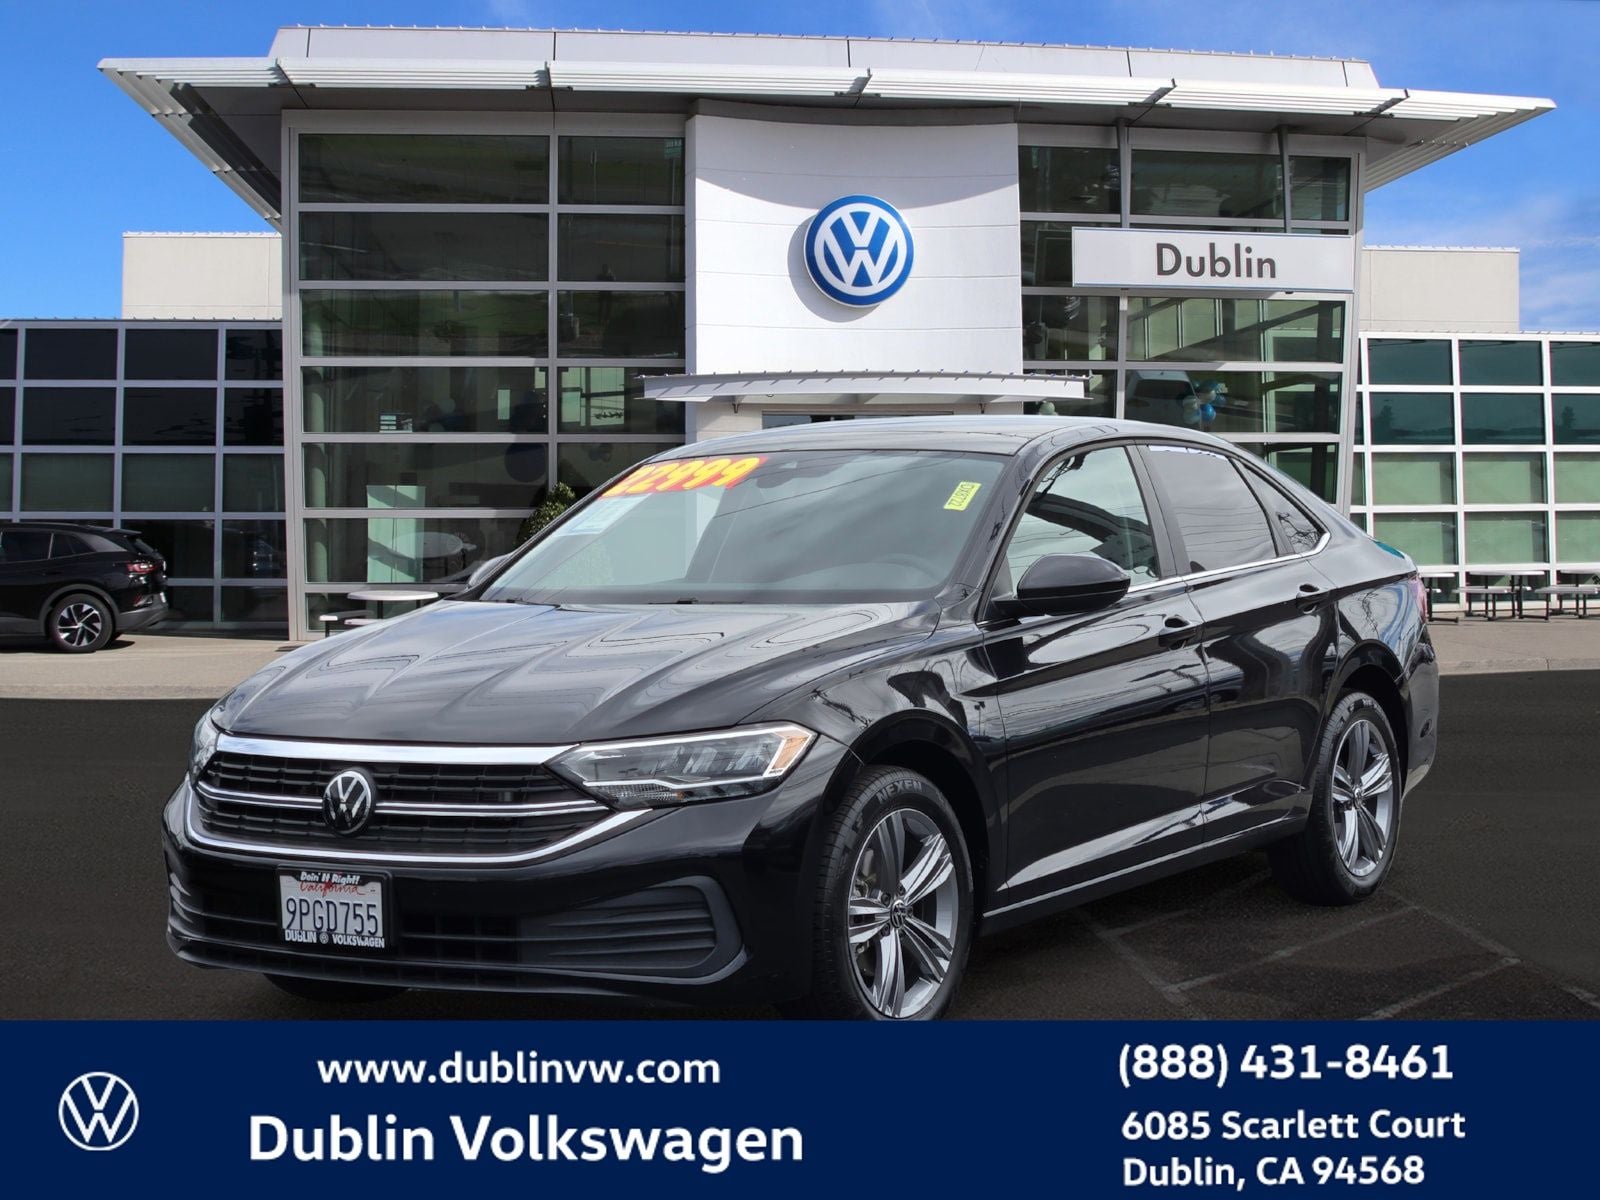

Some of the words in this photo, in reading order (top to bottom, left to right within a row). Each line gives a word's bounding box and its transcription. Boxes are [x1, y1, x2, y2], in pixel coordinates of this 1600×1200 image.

[813, 202, 908, 297] VW
[1156, 242, 1277, 278] Dublin
[876, 779, 922, 803] NEXEN
[286, 897, 378, 936] 9PGD755
[285, 929, 317, 943] DUBLIN
[332, 933, 385, 949] VOLKSWAGEN
